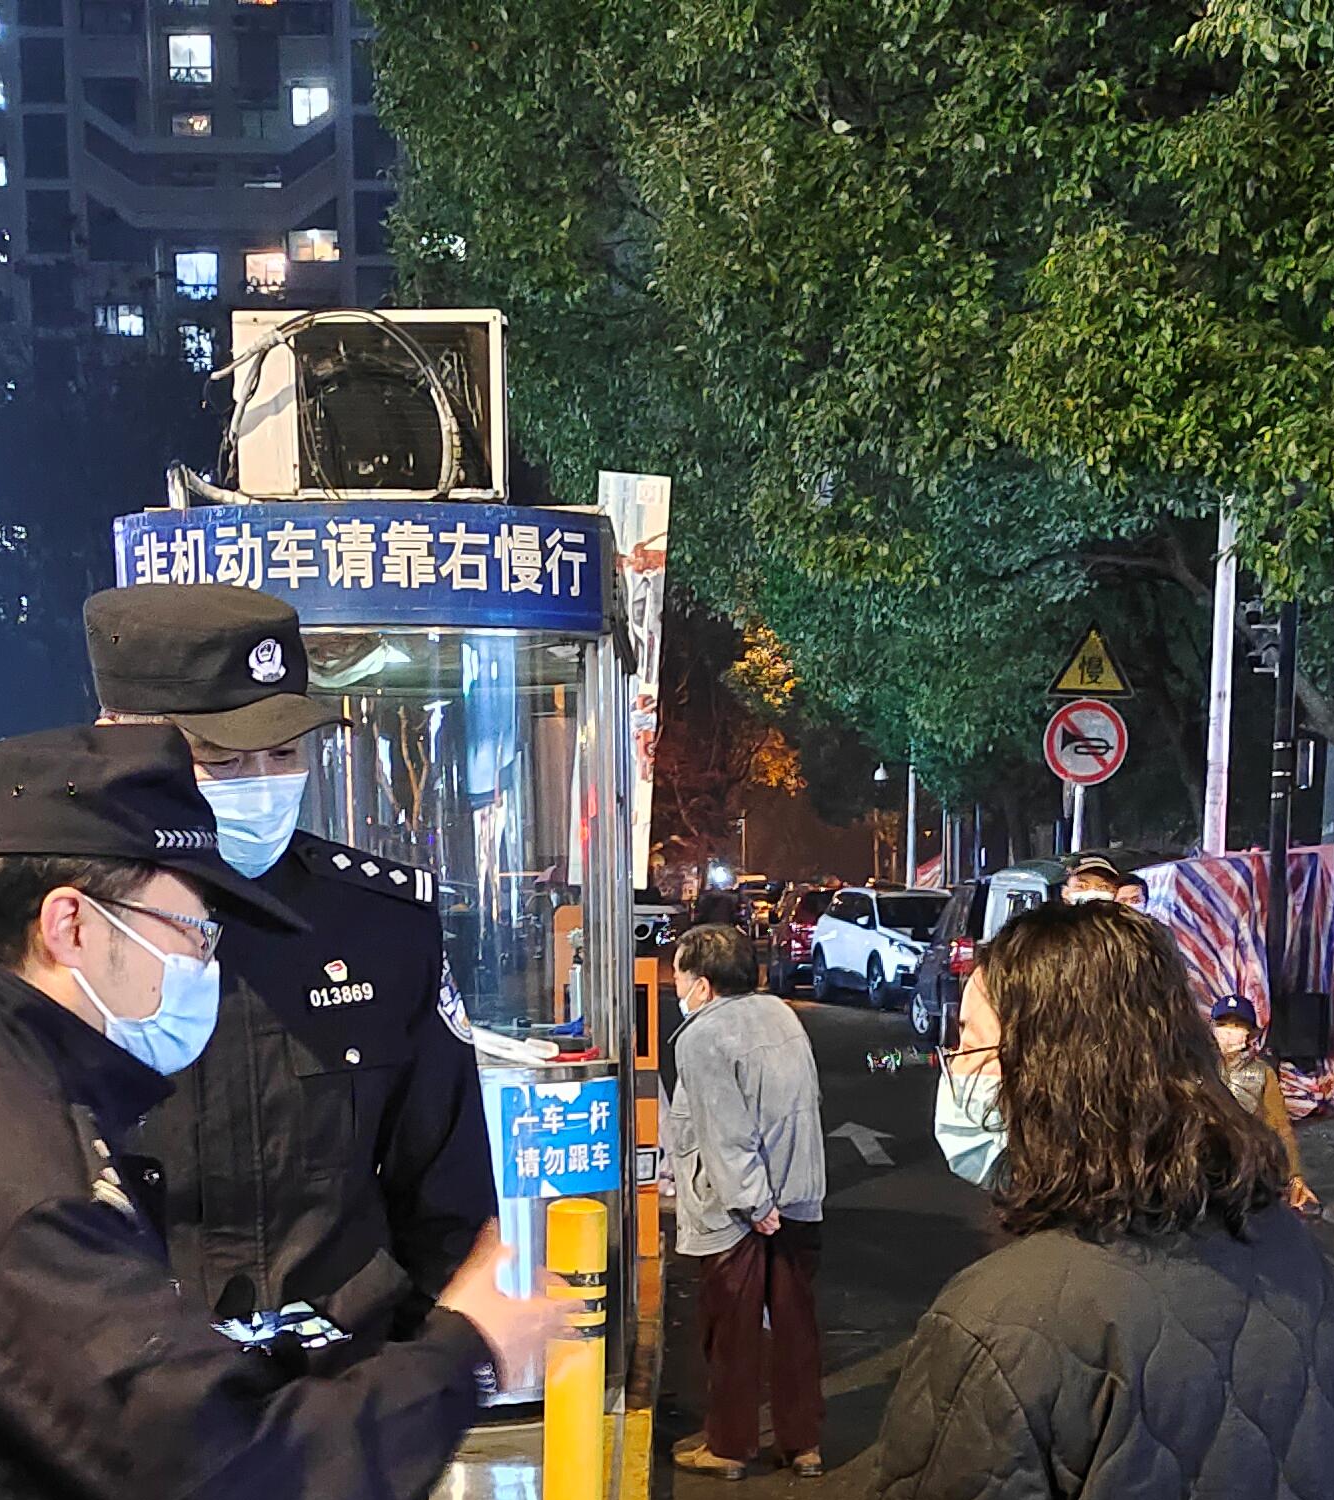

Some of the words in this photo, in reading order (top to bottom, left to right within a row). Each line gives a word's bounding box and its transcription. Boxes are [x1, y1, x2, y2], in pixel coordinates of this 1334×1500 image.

[135, 519, 587, 597] 非机动车请靠右慢行
[1079, 655, 1104, 685] 慢
[310, 982, 374, 1007] 013869
[515, 1142, 612, 1178] 请勿跟车
